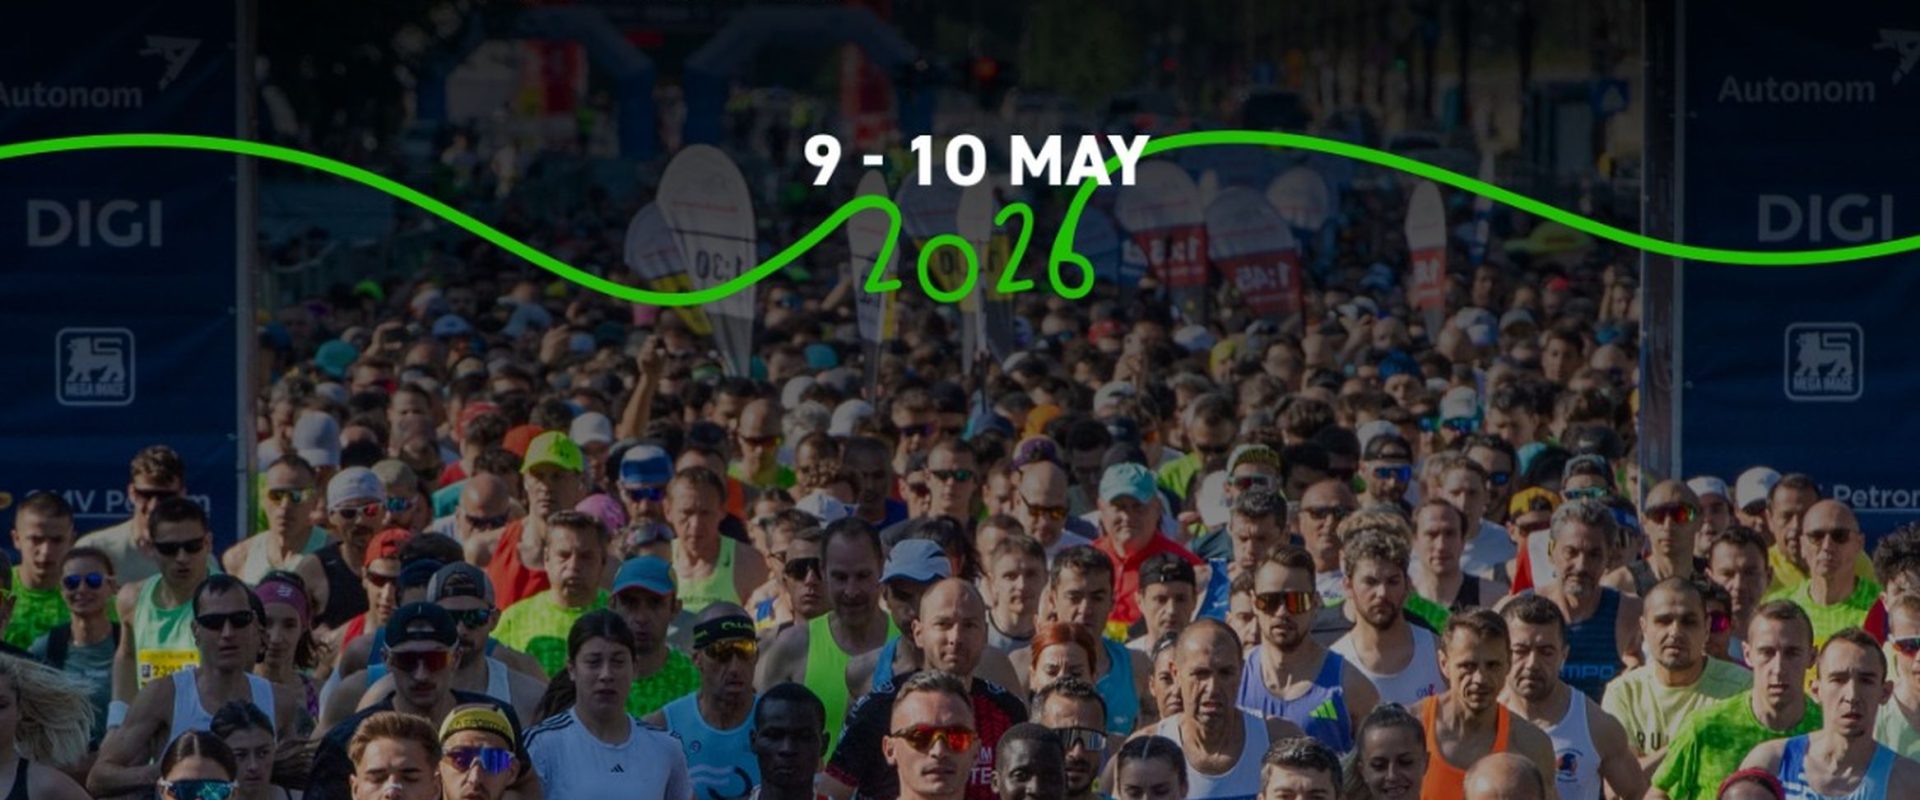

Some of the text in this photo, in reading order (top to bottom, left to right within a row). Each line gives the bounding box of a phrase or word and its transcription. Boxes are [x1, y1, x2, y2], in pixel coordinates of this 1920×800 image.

[1717, 75, 1876, 103] Autonom
[27, 199, 163, 248] DIGI
[1757, 193, 1894, 243] DIGI
